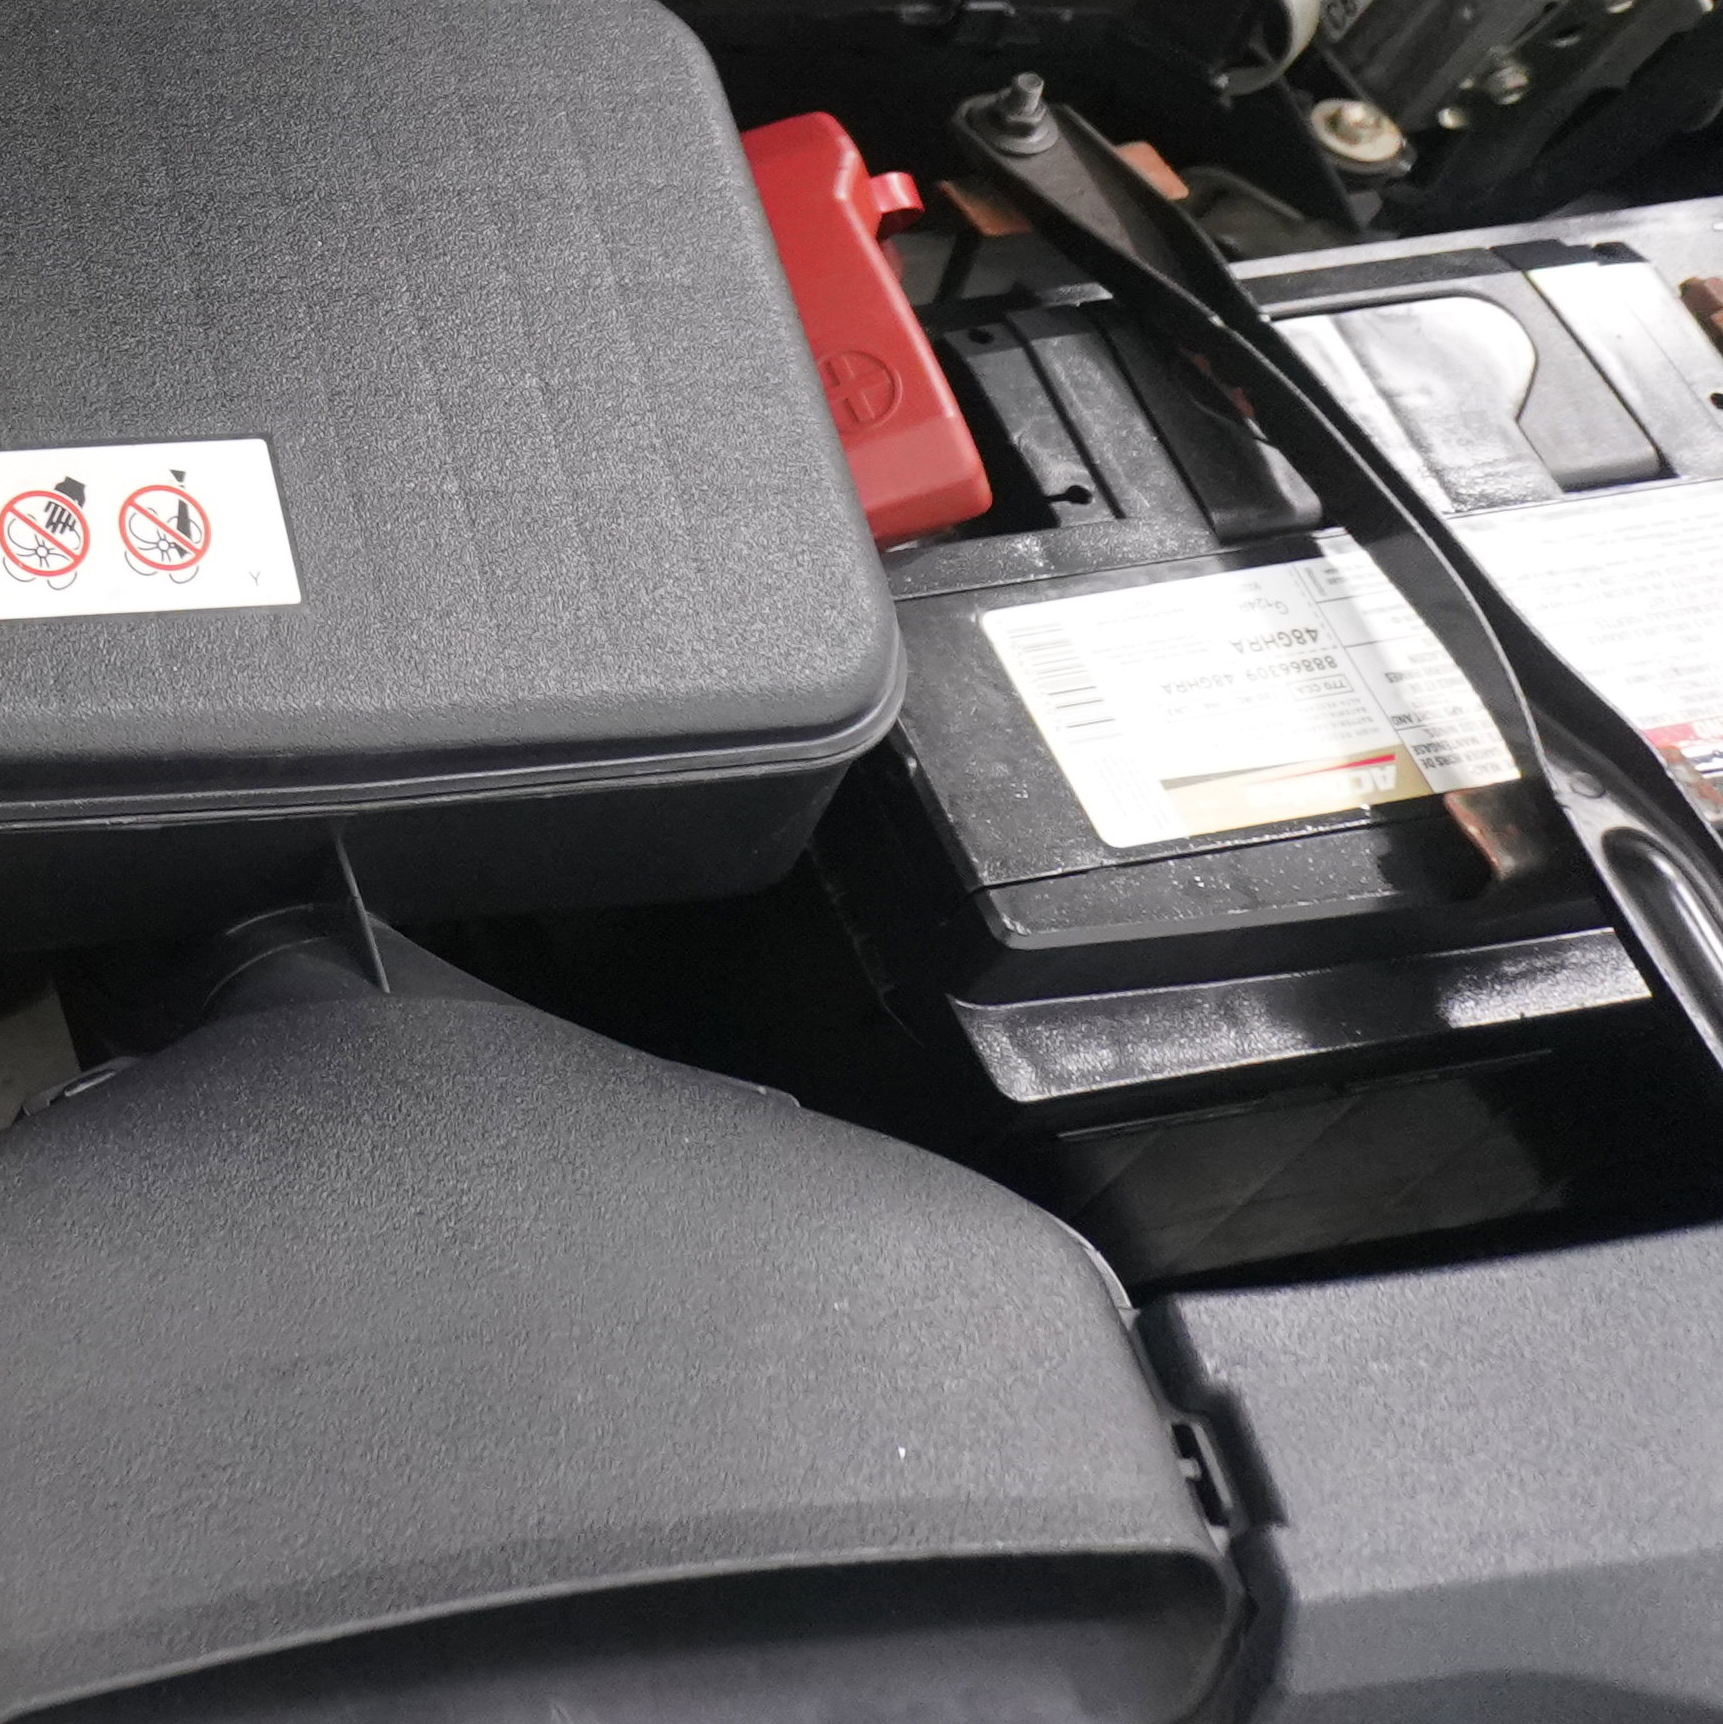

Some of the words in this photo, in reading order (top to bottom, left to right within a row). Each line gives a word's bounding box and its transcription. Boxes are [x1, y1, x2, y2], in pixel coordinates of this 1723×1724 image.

[1227, 625, 1321, 655] 48GHRA
[1243, 654, 1339, 681] 88866309
[1158, 671, 1235, 696] 48GHRA
[1389, 713, 1413, 726] AND
